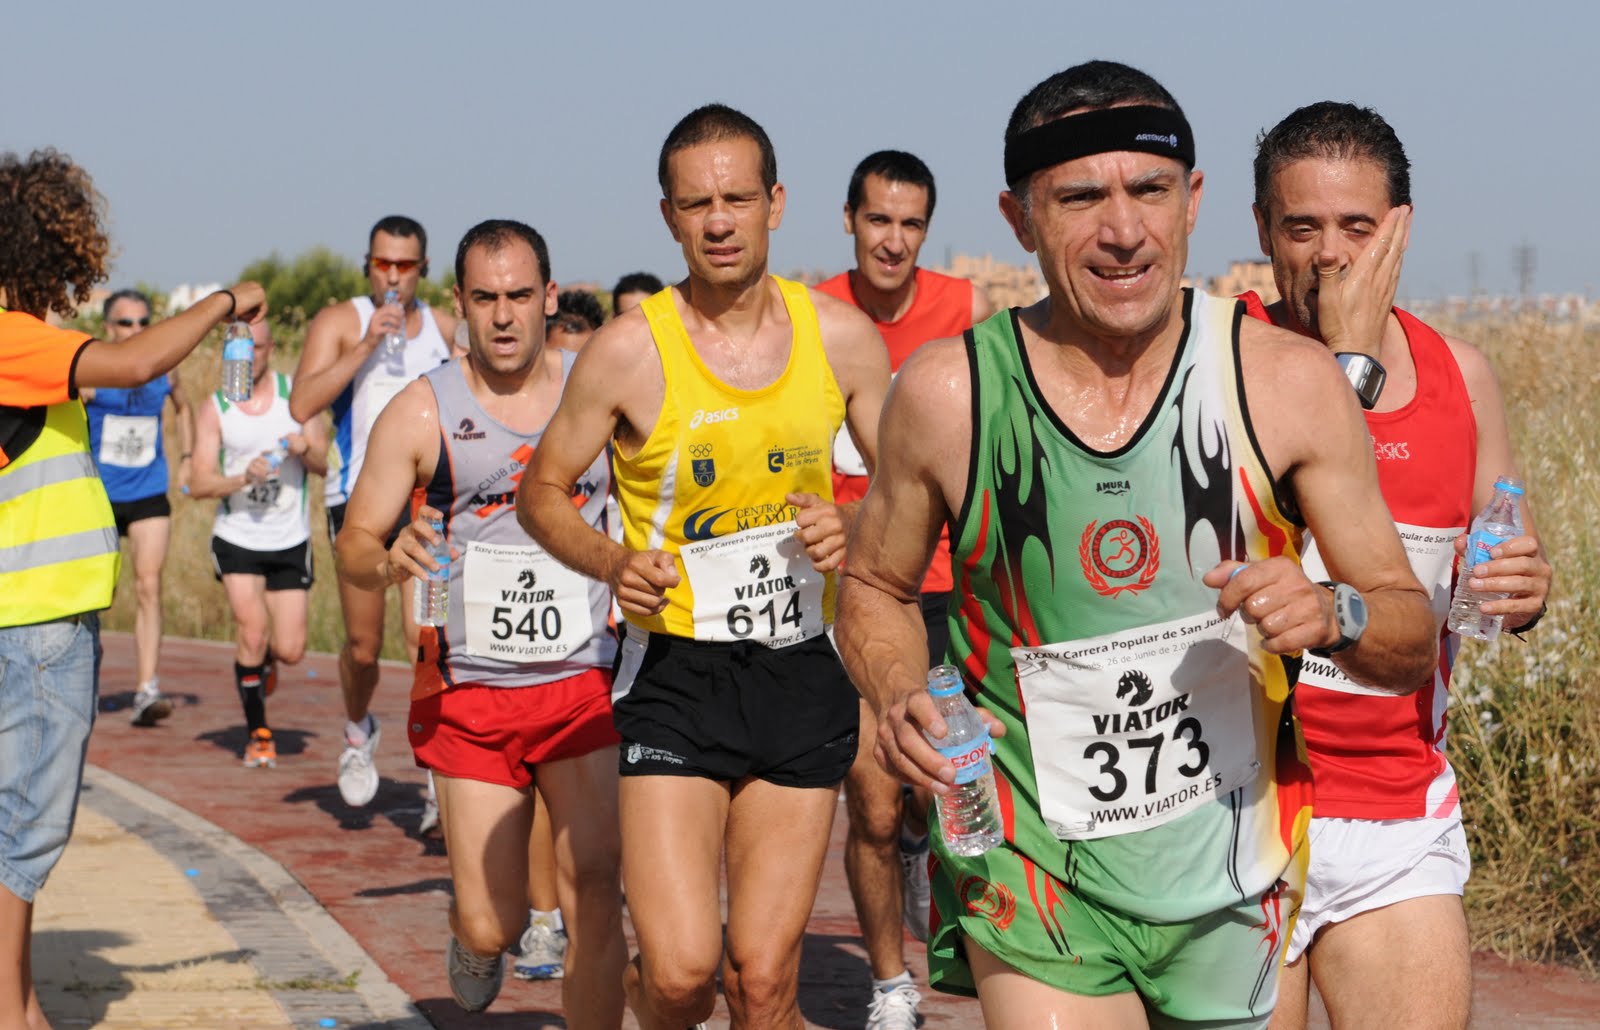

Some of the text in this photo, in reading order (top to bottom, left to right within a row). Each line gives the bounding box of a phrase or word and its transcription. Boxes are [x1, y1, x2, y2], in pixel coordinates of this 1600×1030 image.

[453, 431, 486, 441] VIATOR
[478, 467, 508, 492] CLUB
[1096, 480, 1131, 492] AMURA
[249, 486, 281, 503] 427
[736, 503, 783, 519] CENTRO
[715, 537, 744, 549] Carrera
[746, 531, 775, 543] Popular
[501, 589, 554, 603] VIATOR
[735, 575, 796, 600] VIATOR
[491, 606, 562, 642] 540
[727, 590, 803, 639] 614
[490, 643, 568, 655] WWW.VIATOR.ES
[1063, 645, 1109, 660] Carrera
[1111, 634, 1160, 650] Popular
[1162, 630, 1178, 640] de
[1180, 625, 1202, 636] San
[1108, 657, 1118, 667] 26
[1120, 655, 1132, 663] de
[1134, 650, 1157, 661] Junio
[1159, 646, 1170, 655] de
[1092, 693, 1189, 735] VIATOR
[1082, 717, 1210, 803] 373
[1090, 772, 1223, 824] WWW.VIATOR.ES
